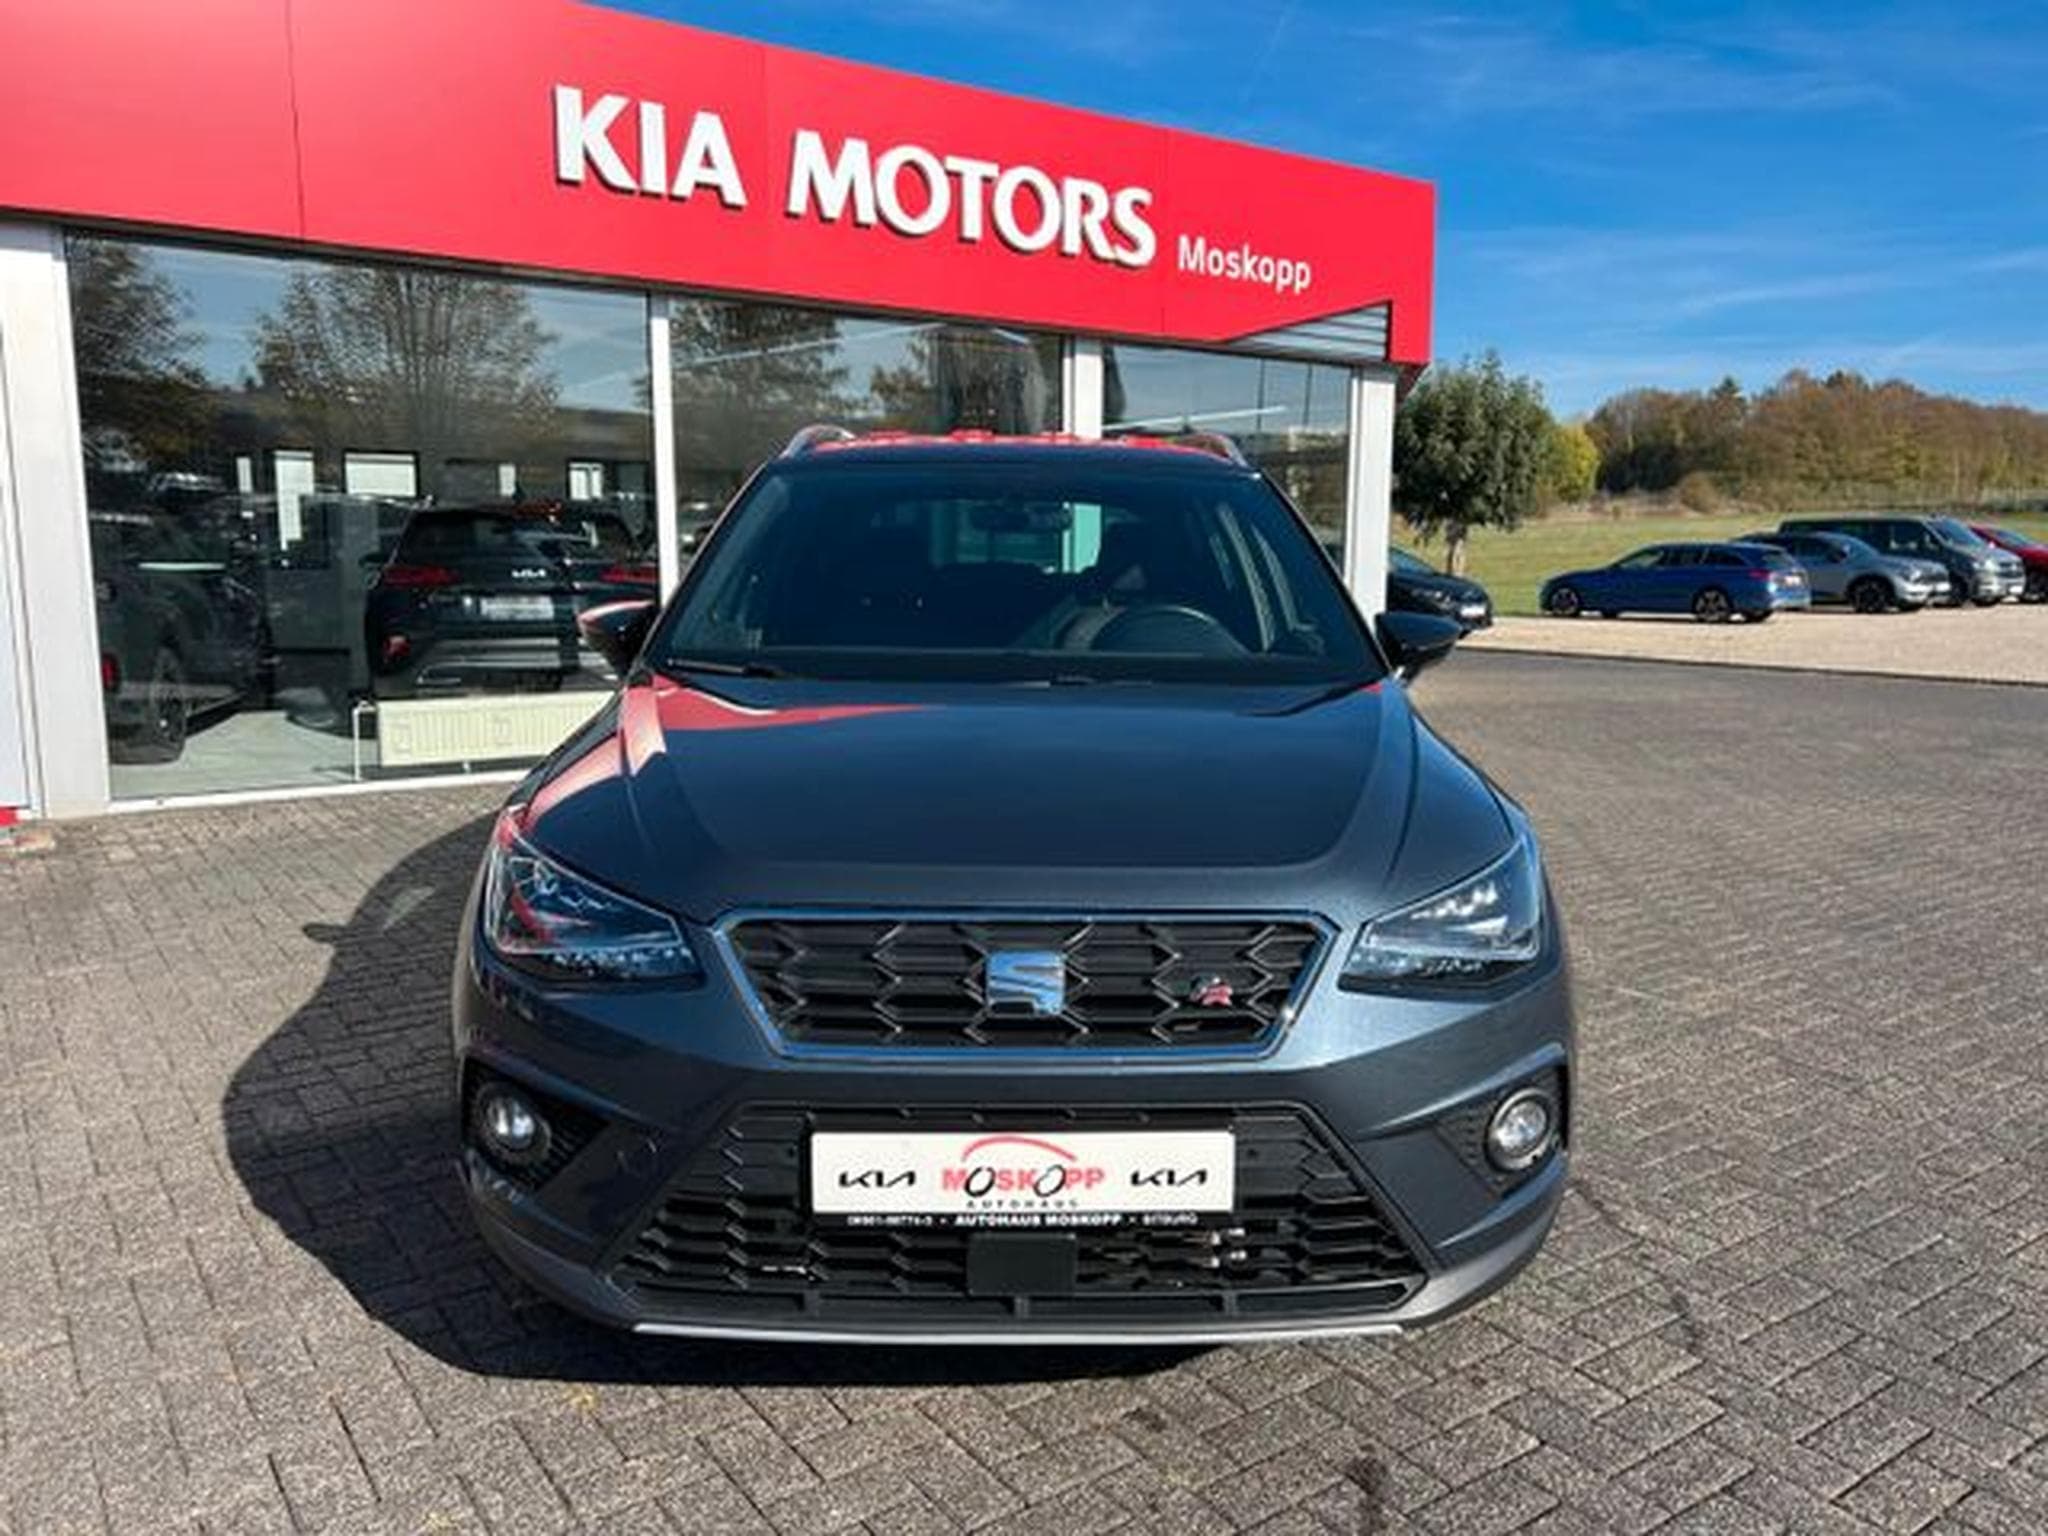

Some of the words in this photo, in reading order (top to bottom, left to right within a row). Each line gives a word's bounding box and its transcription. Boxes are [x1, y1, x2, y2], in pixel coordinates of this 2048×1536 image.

[552, 84, 747, 207] KIA
[784, 129, 1157, 268] MOTORS
[1178, 233, 1312, 294] Moskopp
[838, 1169, 917, 1189] KIA
[942, 1164, 1106, 1198] MOSKOPP
[1130, 1168, 1208, 1188] KIA
[954, 1214, 1041, 1227] AUTOHAUS
[1045, 1213, 1122, 1227] MOSKOPP
